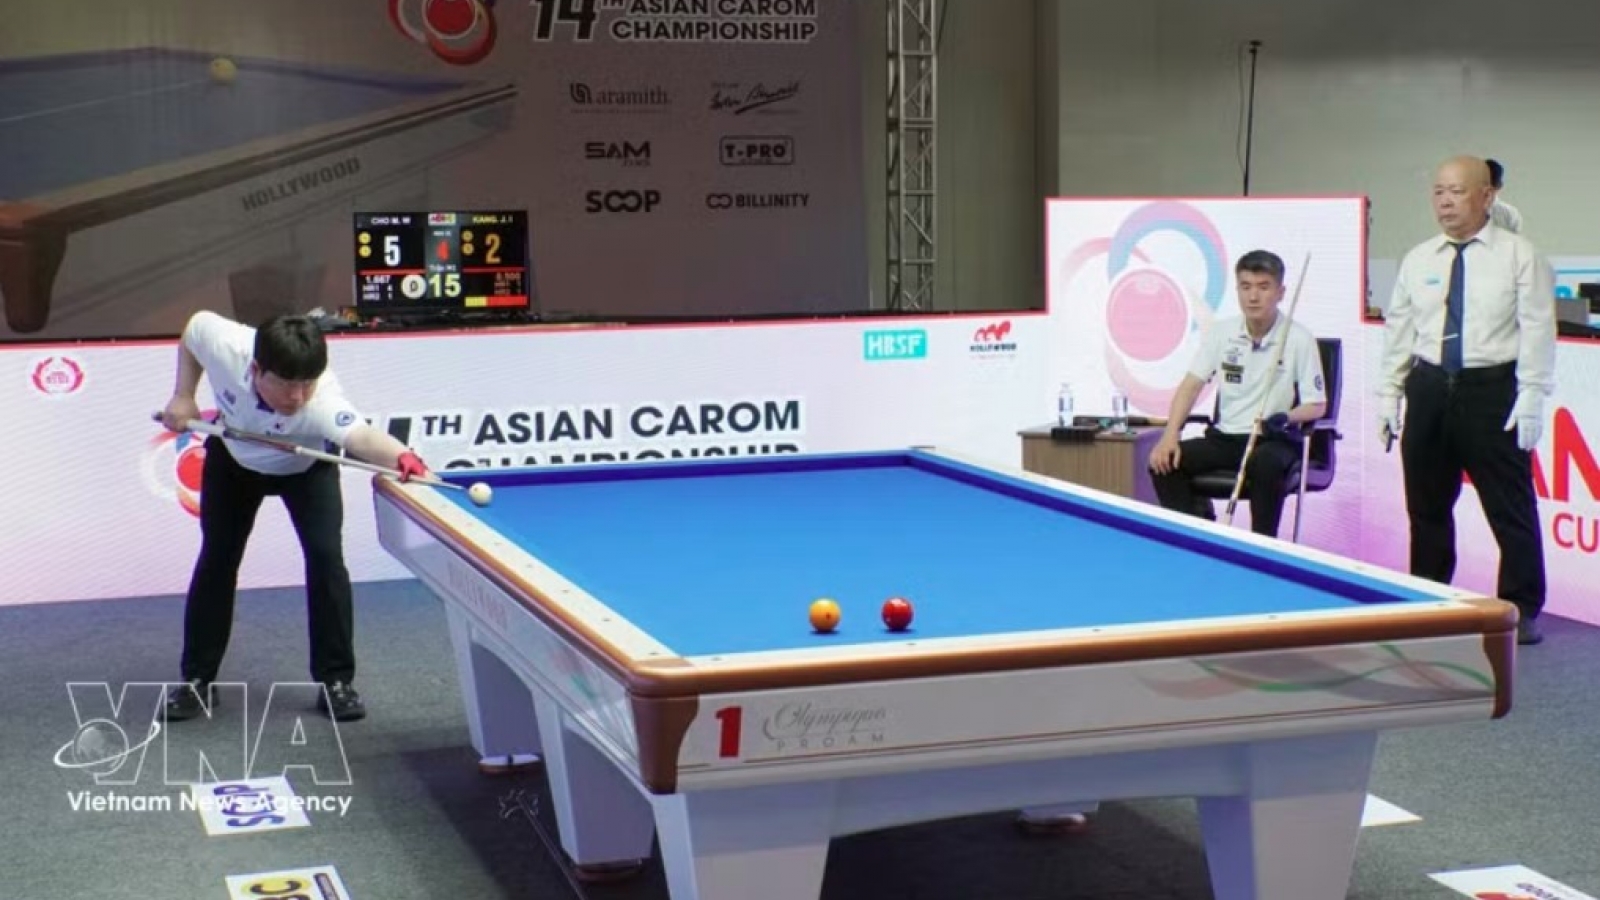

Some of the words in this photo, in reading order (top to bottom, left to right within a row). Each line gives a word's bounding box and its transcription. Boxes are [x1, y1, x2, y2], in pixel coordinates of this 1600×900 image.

[630, 0, 708, 14] ASIAN
[717, 0, 816, 16] CAROM
[612, 20, 816, 40] CHAMPIONSHIP
[595, 84, 668, 106] aramith
[585, 141, 650, 159] SAM
[725, 144, 787, 158] T-PRO
[241, 157, 362, 212] HOLLYWOOD
[585, 190, 661, 213] SOOP
[735, 193, 809, 209] BILLINITY
[384, 236, 400, 266] 5
[485, 234, 501, 264] 2
[428, 273, 462, 298] 15
[867, 333, 923, 357] HBSF
[474, 408, 613, 445] ASIAN
[630, 400, 800, 438] CAROM
[715, 706, 743, 758] 1
